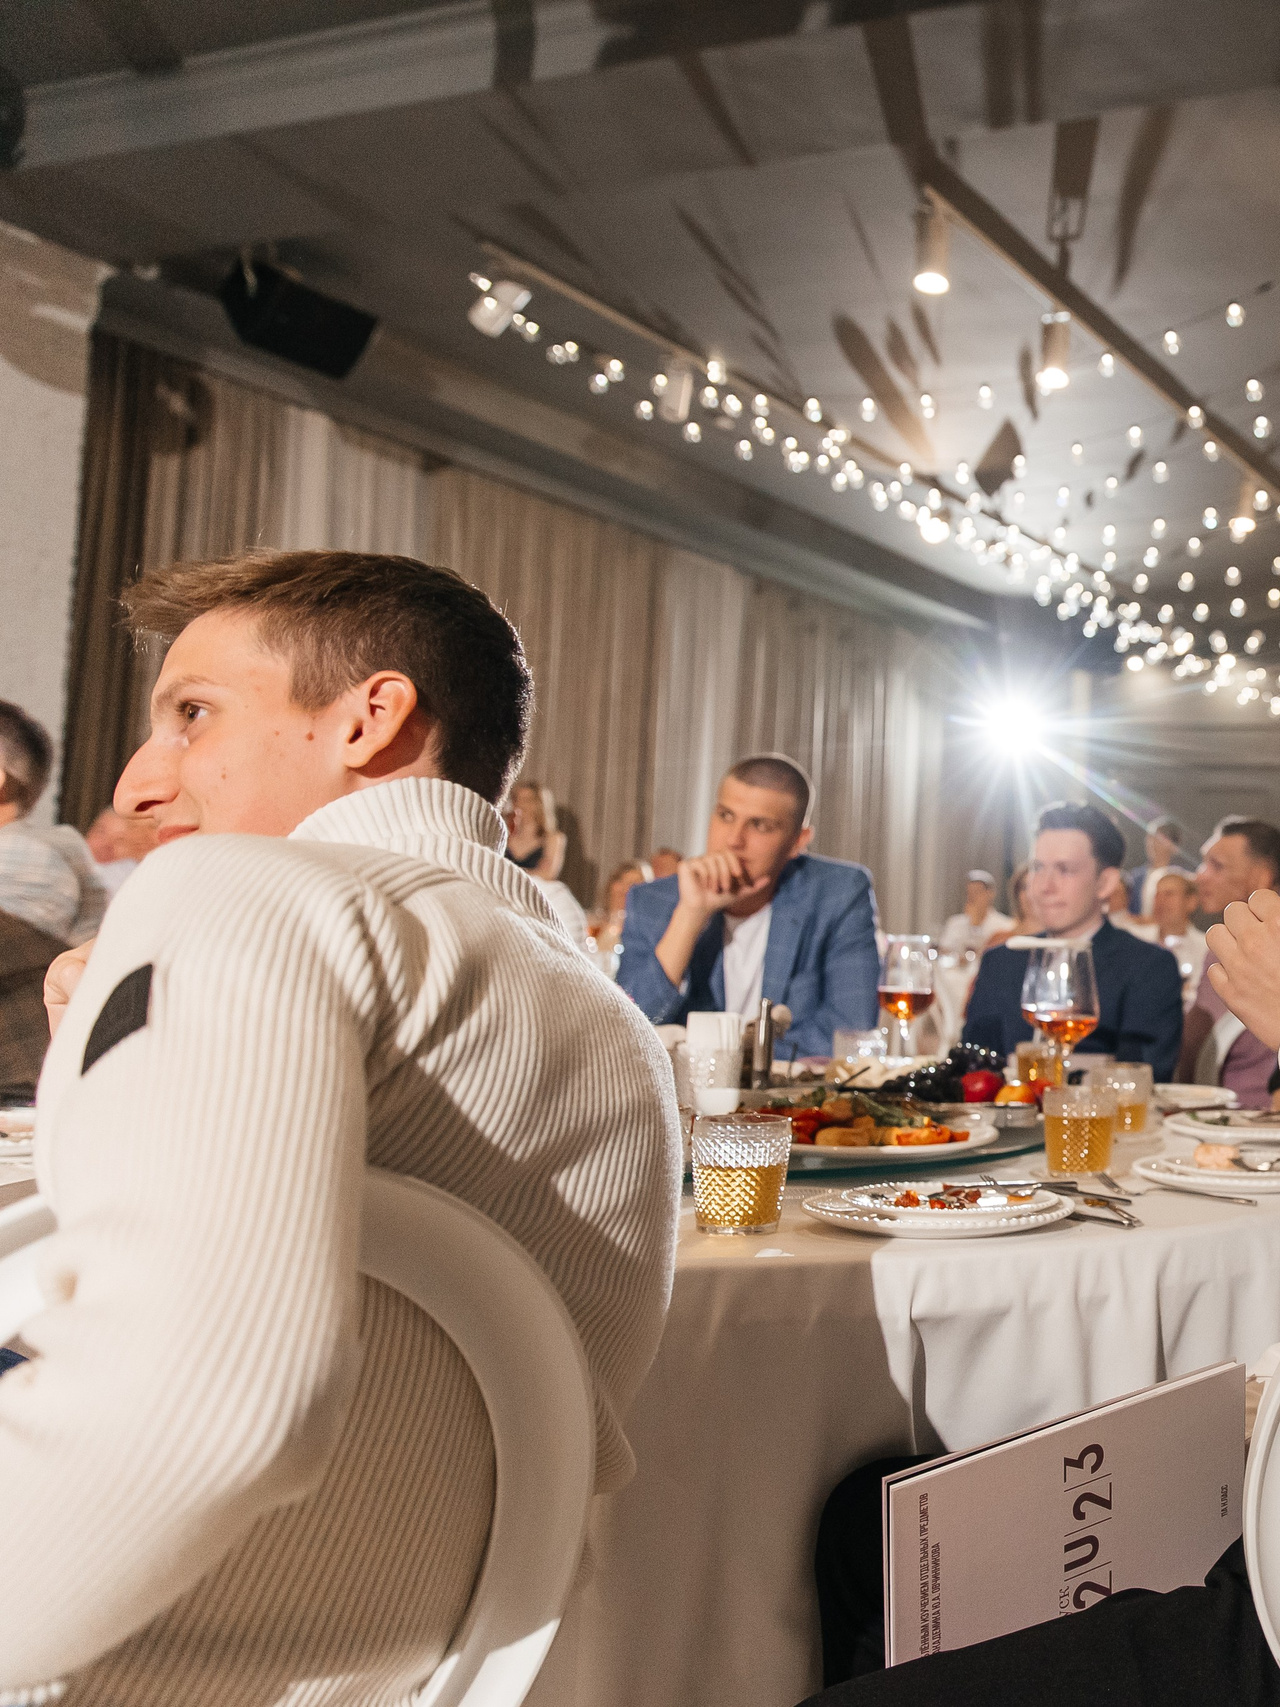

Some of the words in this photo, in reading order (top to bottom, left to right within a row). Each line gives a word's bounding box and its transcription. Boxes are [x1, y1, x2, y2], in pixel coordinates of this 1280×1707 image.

[919, 1492, 929, 1537] ПРЕДМЕТОВ
[919, 1536, 930, 1581] ОТДЕЛЬНЫХ
[931, 1542, 941, 1594] ОВЧИННИКОВА
[920, 1580, 930, 1624] ИЗУЧЕНИЕМ
